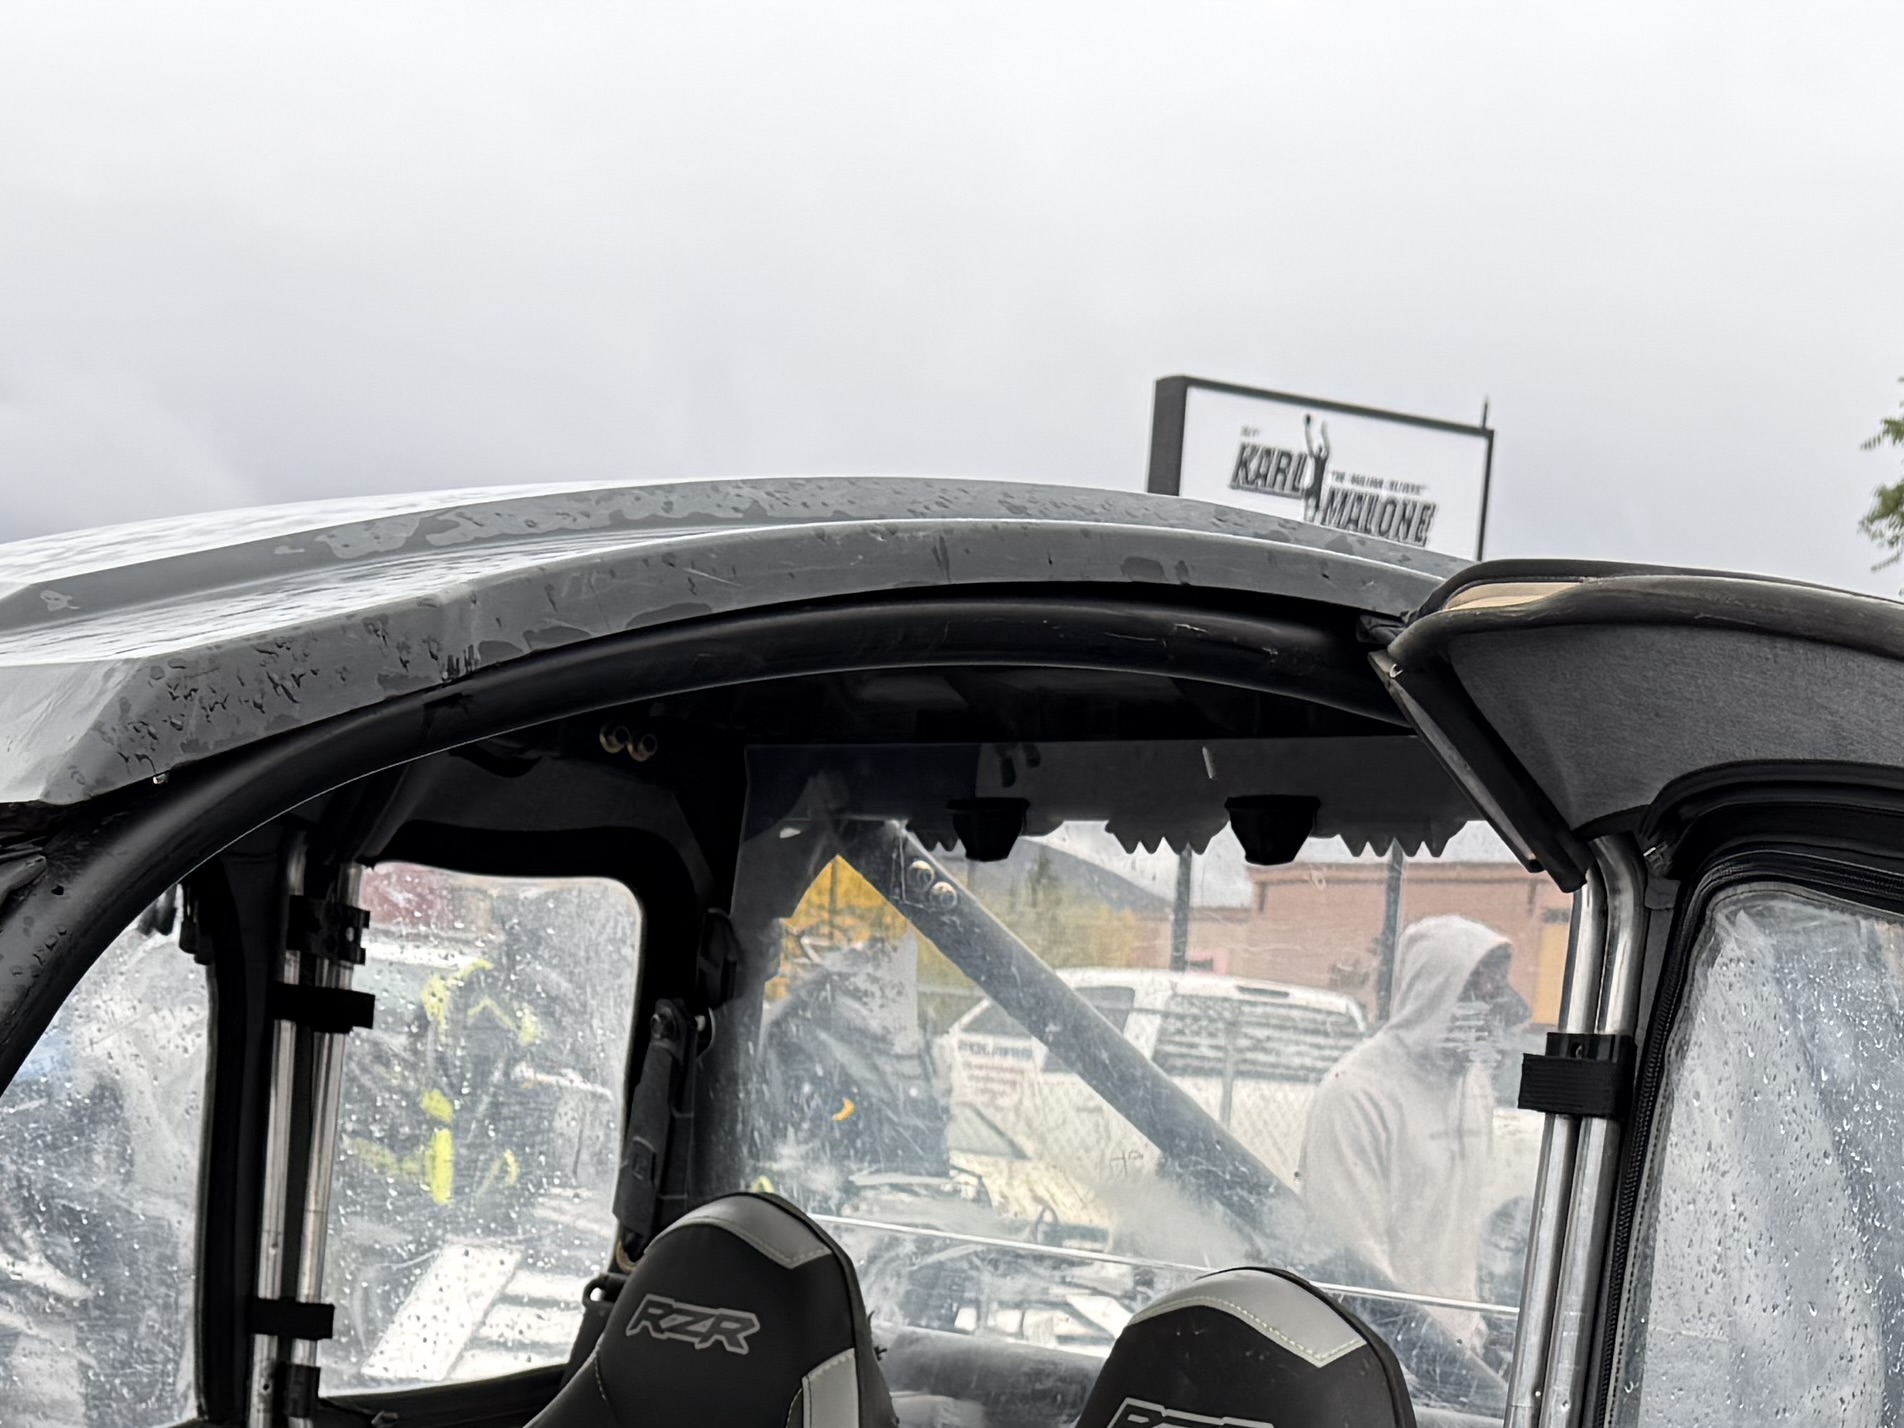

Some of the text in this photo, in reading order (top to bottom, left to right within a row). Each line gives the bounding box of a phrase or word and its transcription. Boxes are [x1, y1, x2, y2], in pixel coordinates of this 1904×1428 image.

[1230, 442, 1309, 499] KARL
[1322, 486, 1437, 546] MALONE
[625, 1294, 761, 1355] RZR
